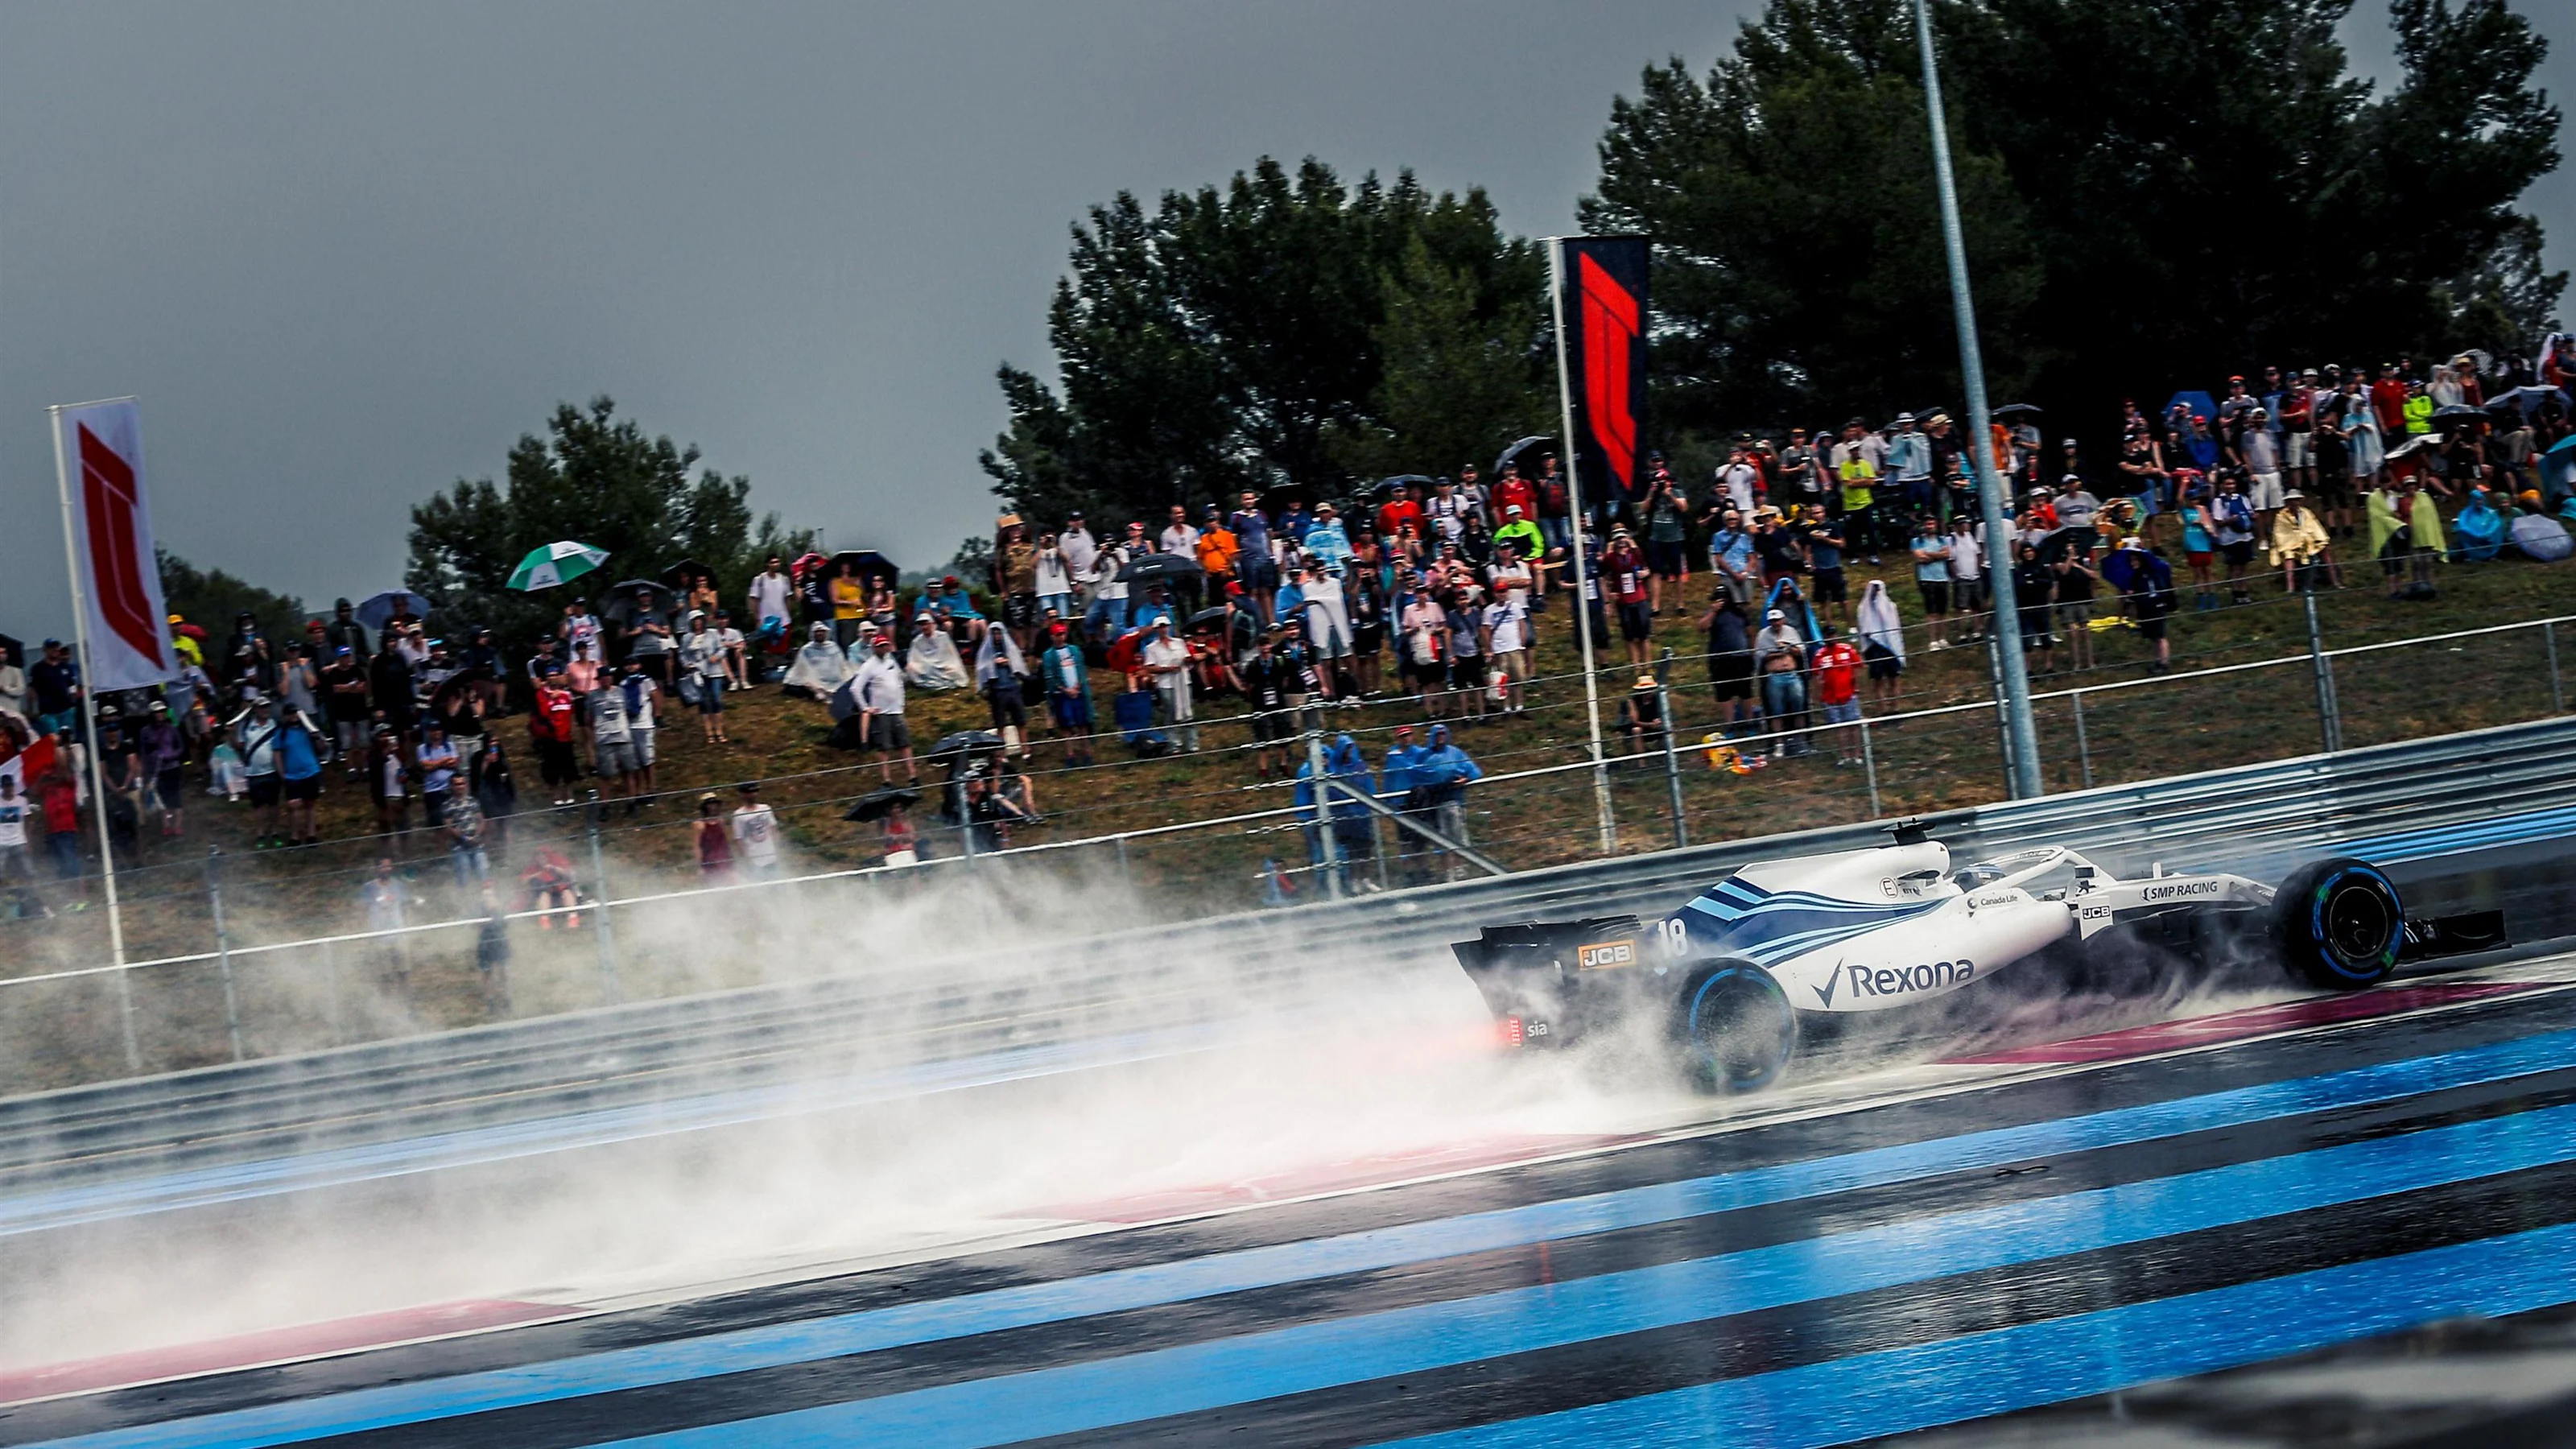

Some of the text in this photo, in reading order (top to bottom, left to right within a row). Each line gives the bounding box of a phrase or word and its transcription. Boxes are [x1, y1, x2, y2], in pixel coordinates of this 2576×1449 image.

[1980, 894, 2018, 906] Canada Life
[2150, 881, 2218, 900] SMP RACING
[2083, 906, 2110, 919] JCB
[1657, 918, 1688, 958] 18
[1583, 945, 1631, 967] JCB
[1847, 958, 1975, 998] Rexona
